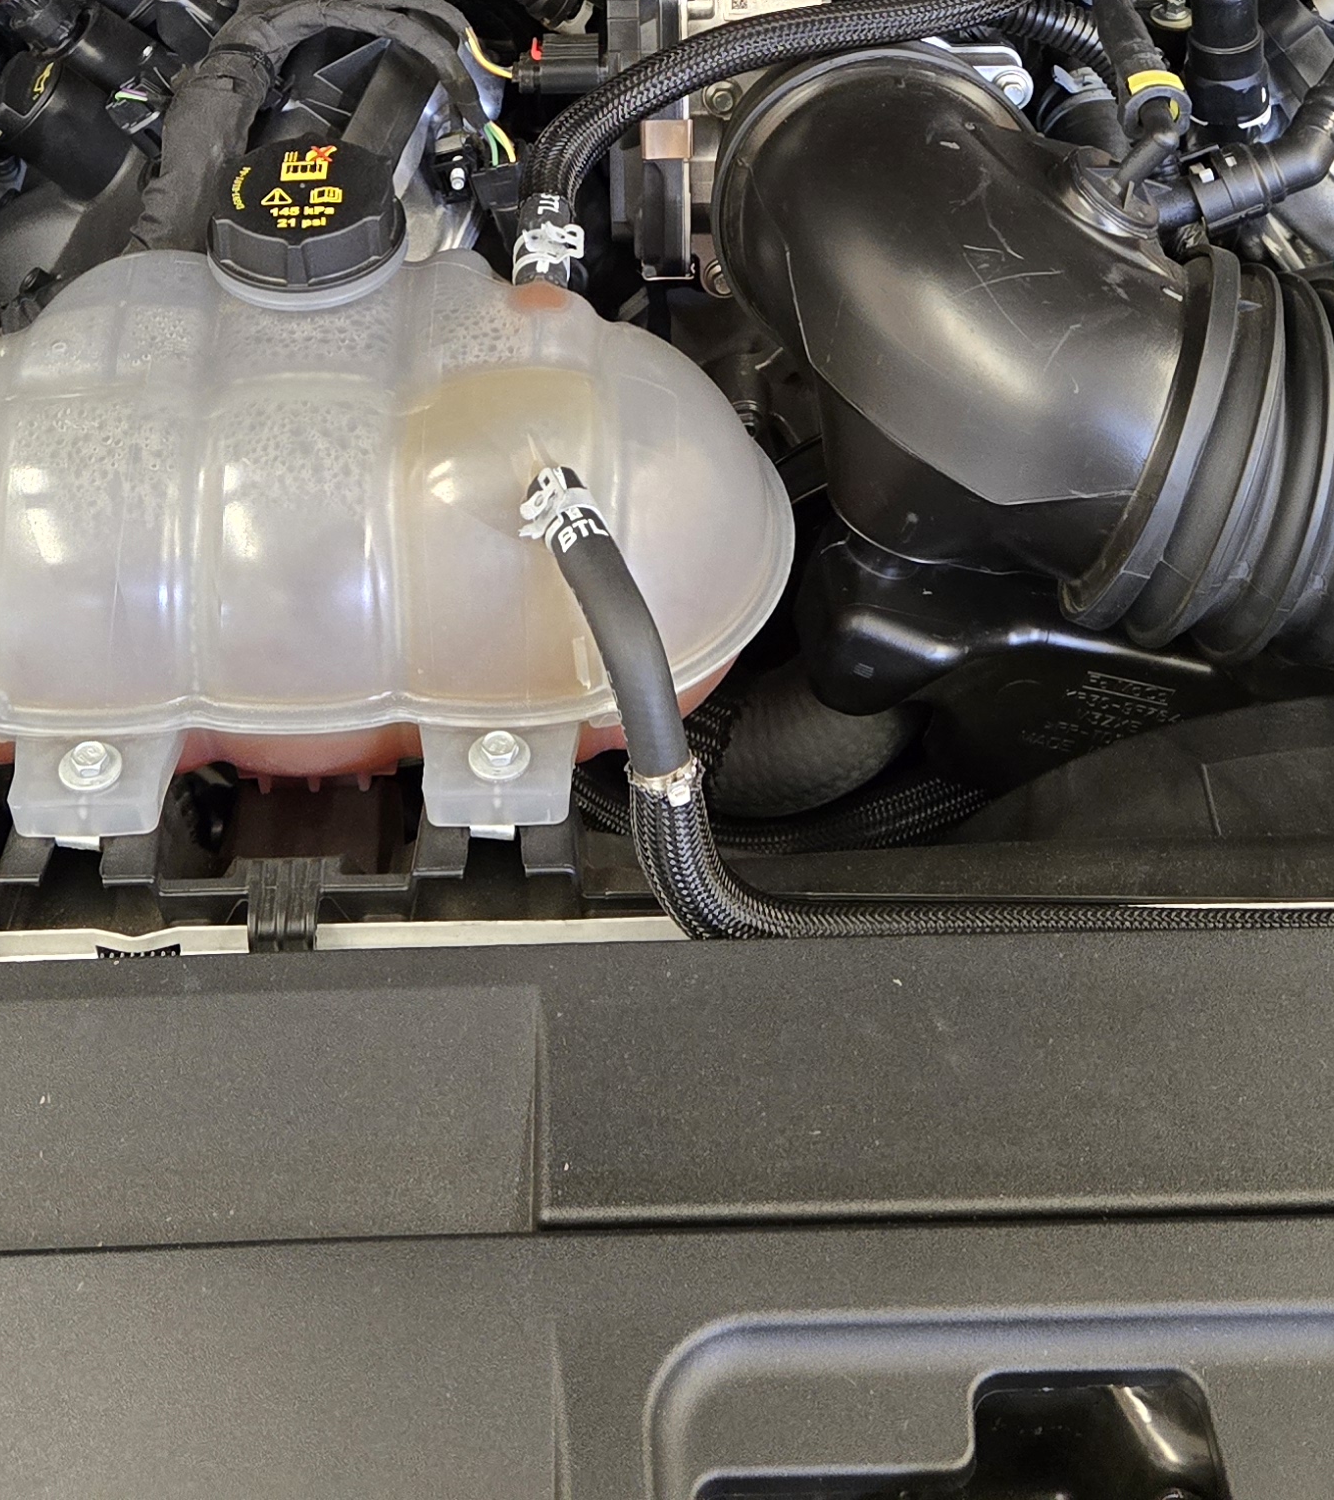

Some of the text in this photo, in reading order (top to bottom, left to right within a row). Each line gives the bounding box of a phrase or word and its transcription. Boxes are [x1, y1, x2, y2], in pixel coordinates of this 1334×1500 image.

[270, 205, 335, 217] 145 kPa
[277, 217, 326, 228] 21 psi
[557, 518, 609, 553] BTL
